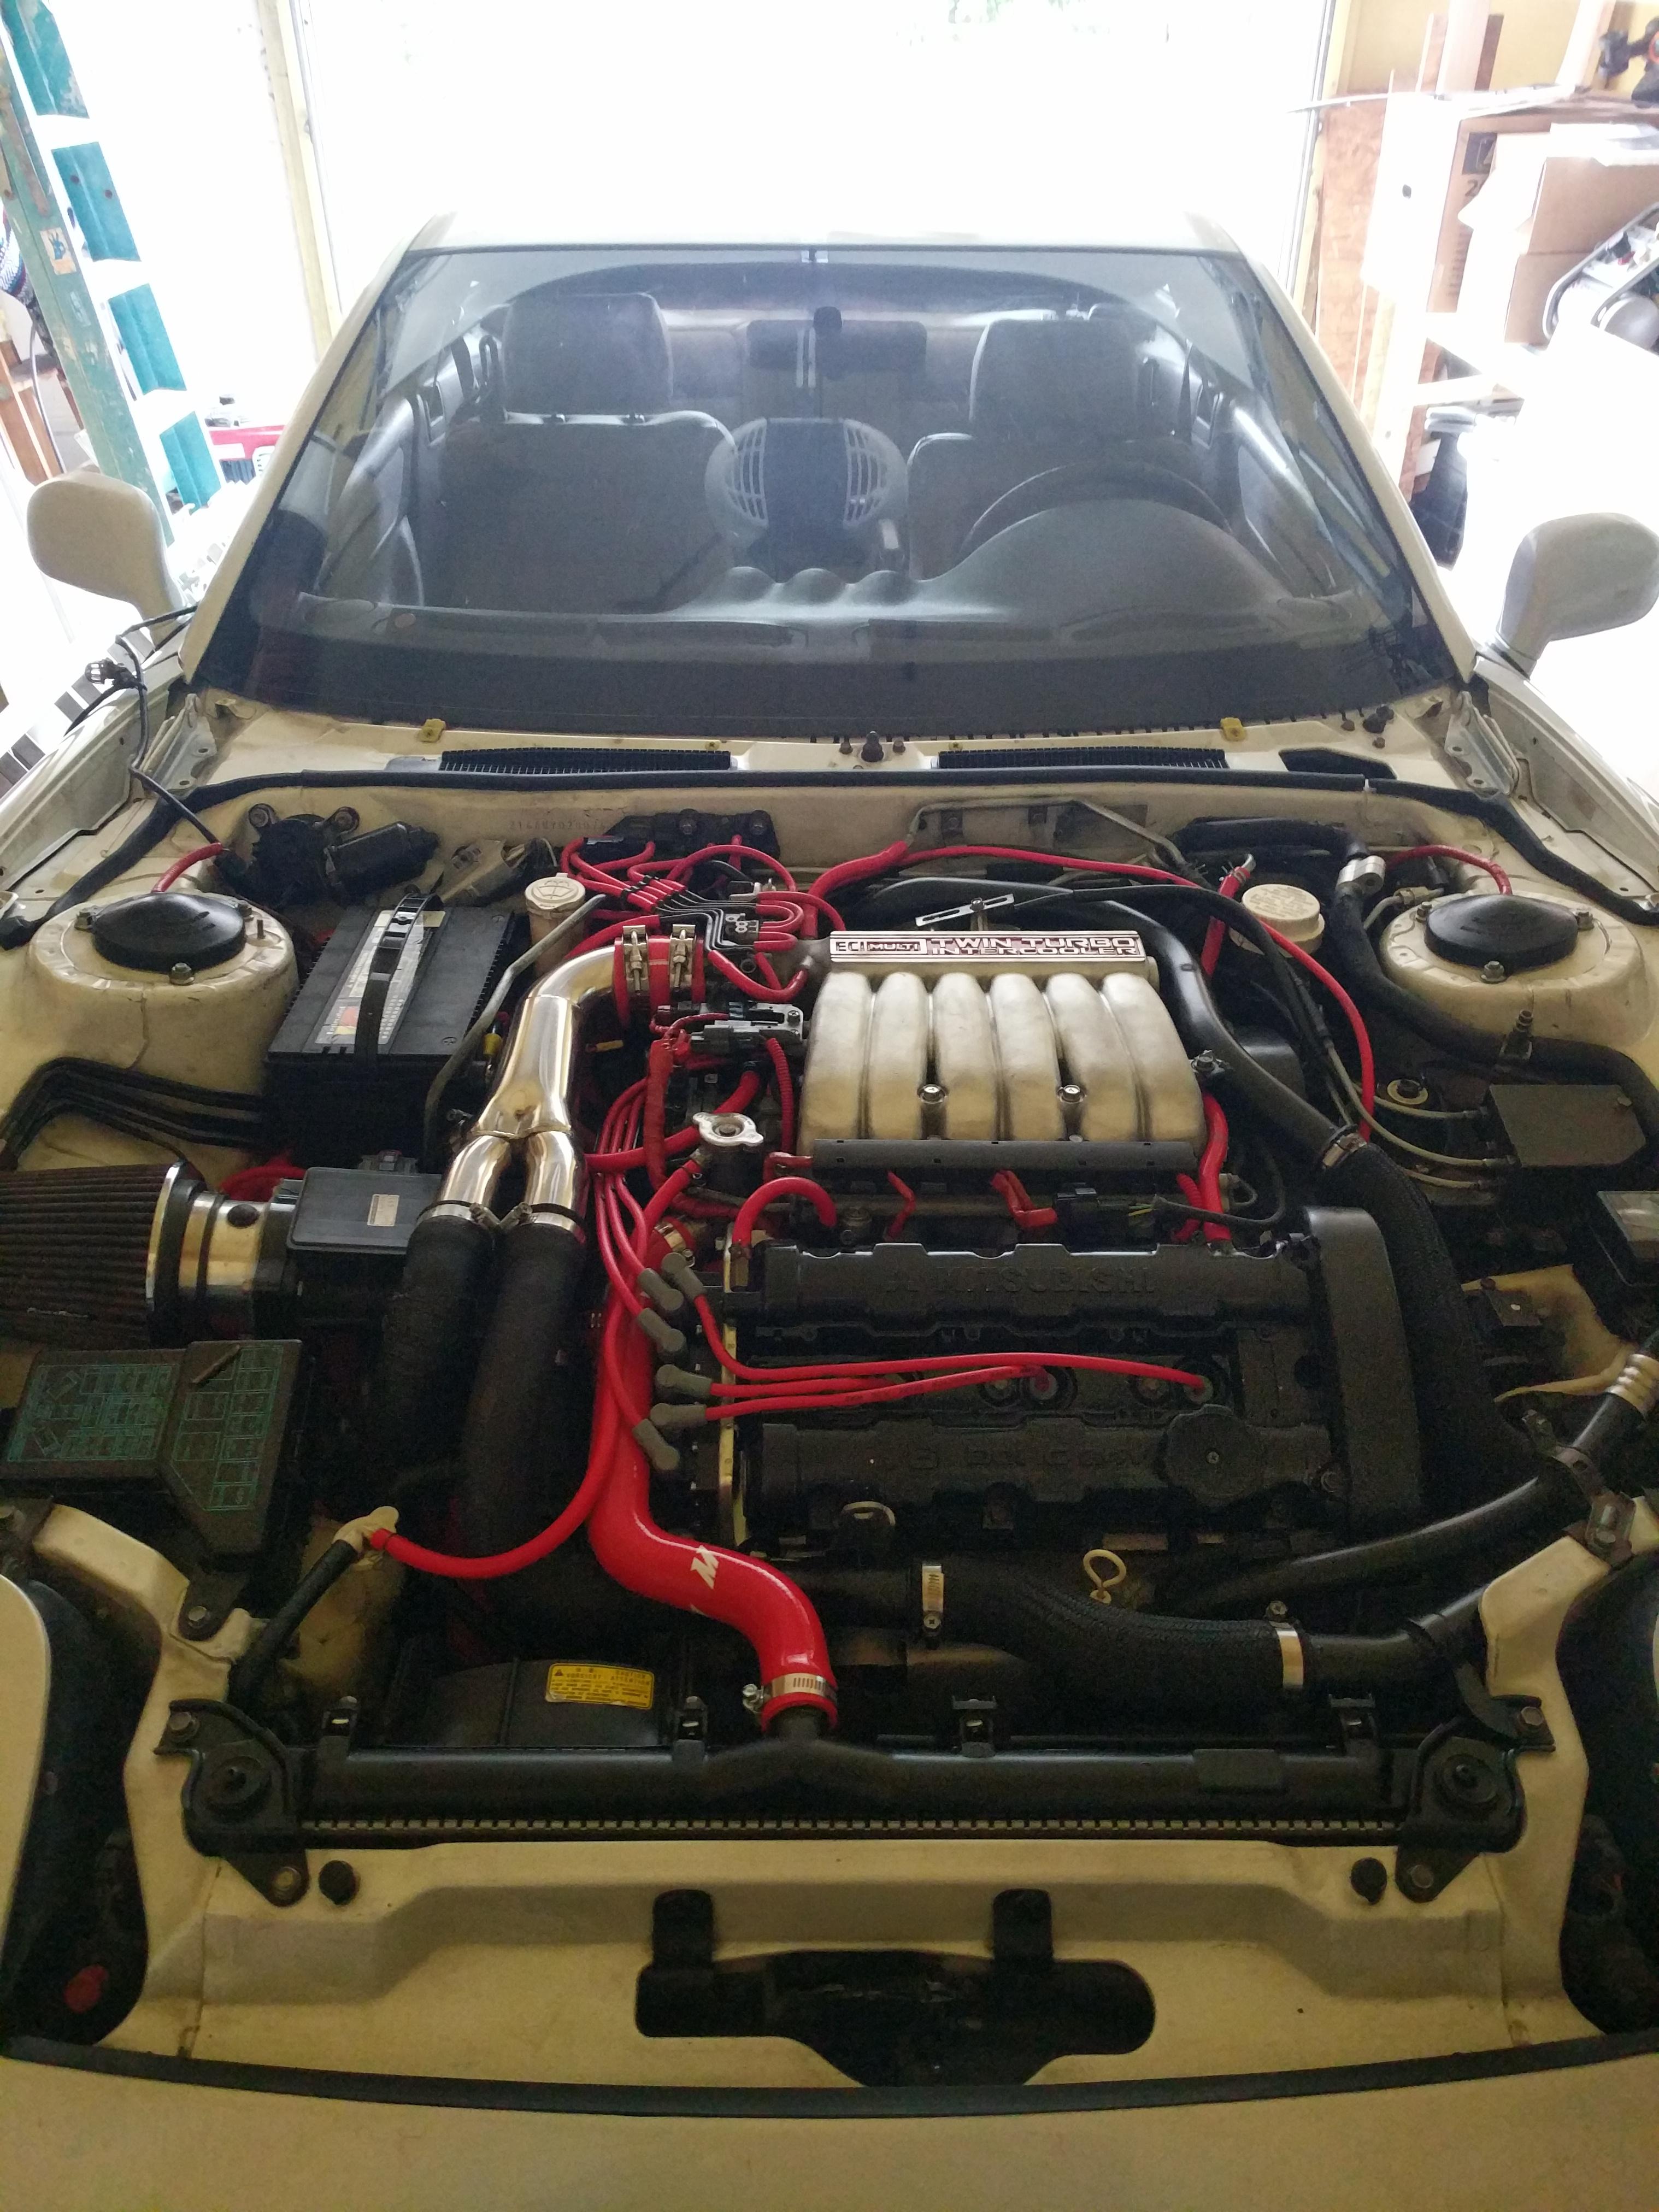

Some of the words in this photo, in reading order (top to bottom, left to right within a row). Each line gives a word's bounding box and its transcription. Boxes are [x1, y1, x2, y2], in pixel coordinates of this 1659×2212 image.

[836, 942, 865, 951] ECI
[869, 943, 920, 951] MULTI
[931, 938, 1012, 948] TWIN
[1021, 938, 1135, 948] TURBO
